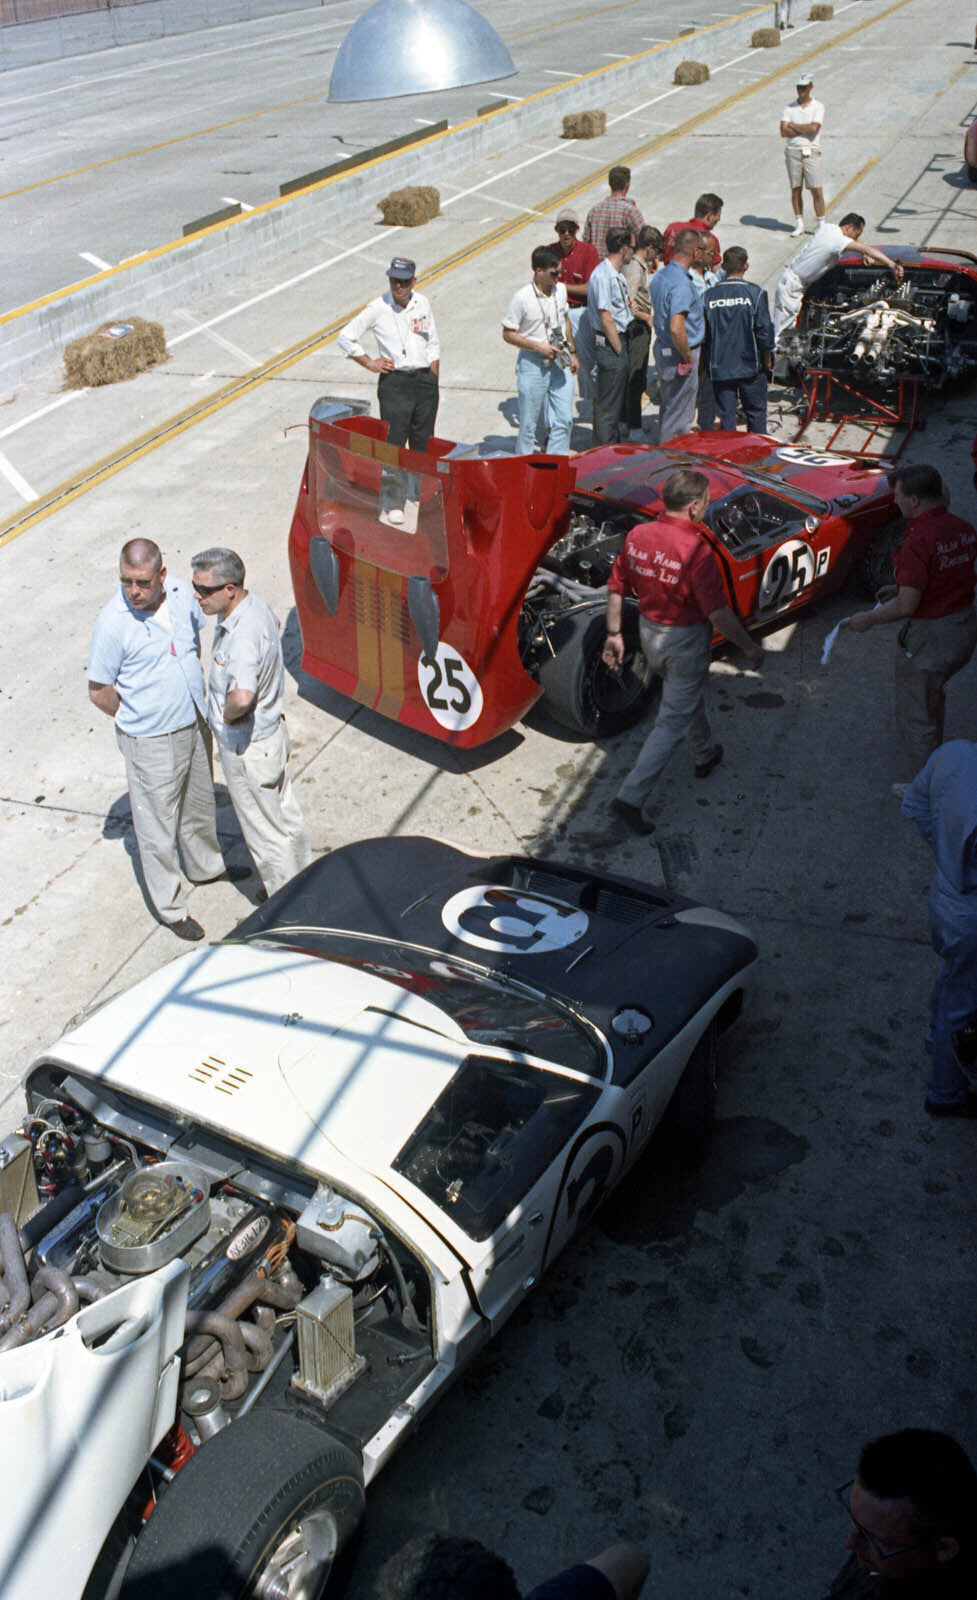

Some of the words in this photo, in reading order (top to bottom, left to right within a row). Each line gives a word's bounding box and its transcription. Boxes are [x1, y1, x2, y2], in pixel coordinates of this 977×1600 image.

[709, 297, 752, 309] COBRA
[762, 545, 808, 613] 25
[817, 551, 828, 575] P
[421, 655, 472, 714] 25
